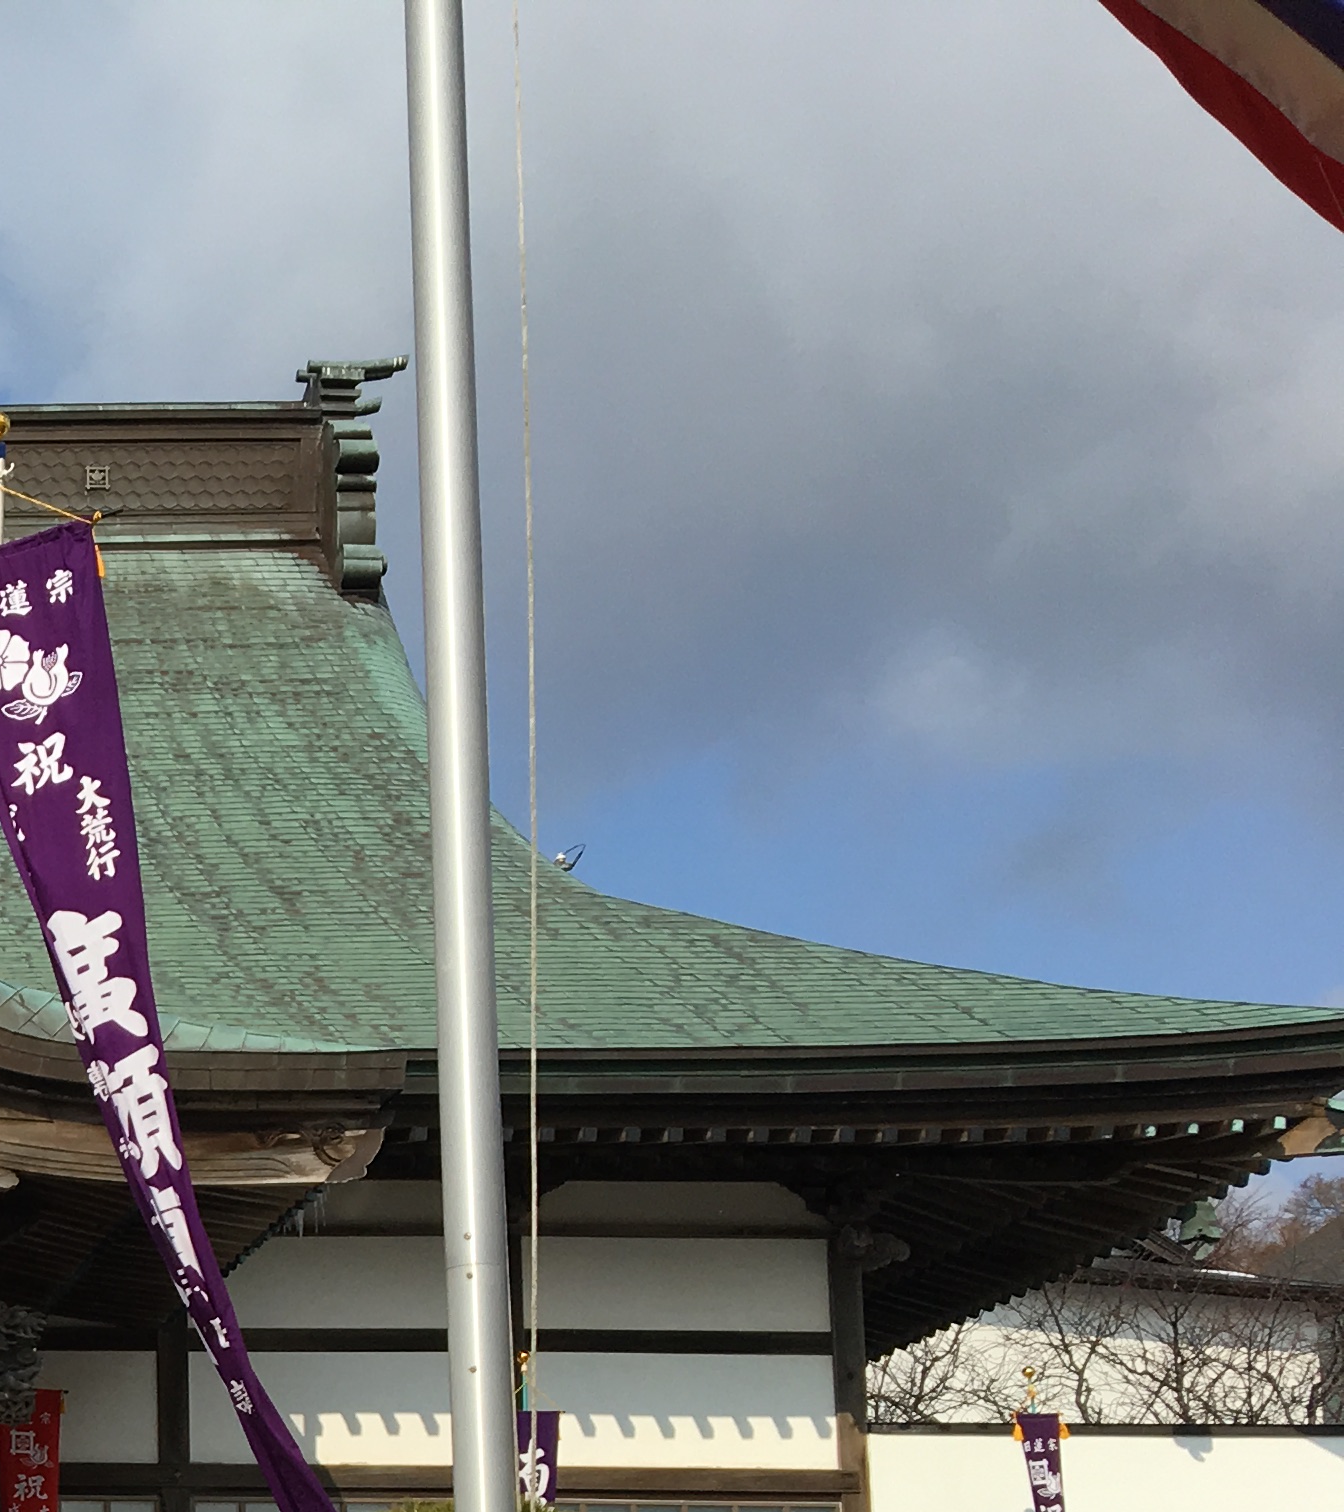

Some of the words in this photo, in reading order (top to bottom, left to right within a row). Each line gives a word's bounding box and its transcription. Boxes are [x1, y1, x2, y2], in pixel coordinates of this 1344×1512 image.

[10, 731, 74, 796] 祝
[75, 776, 122, 882] 大荒行
[13, 1474, 48, 1501] 祝
